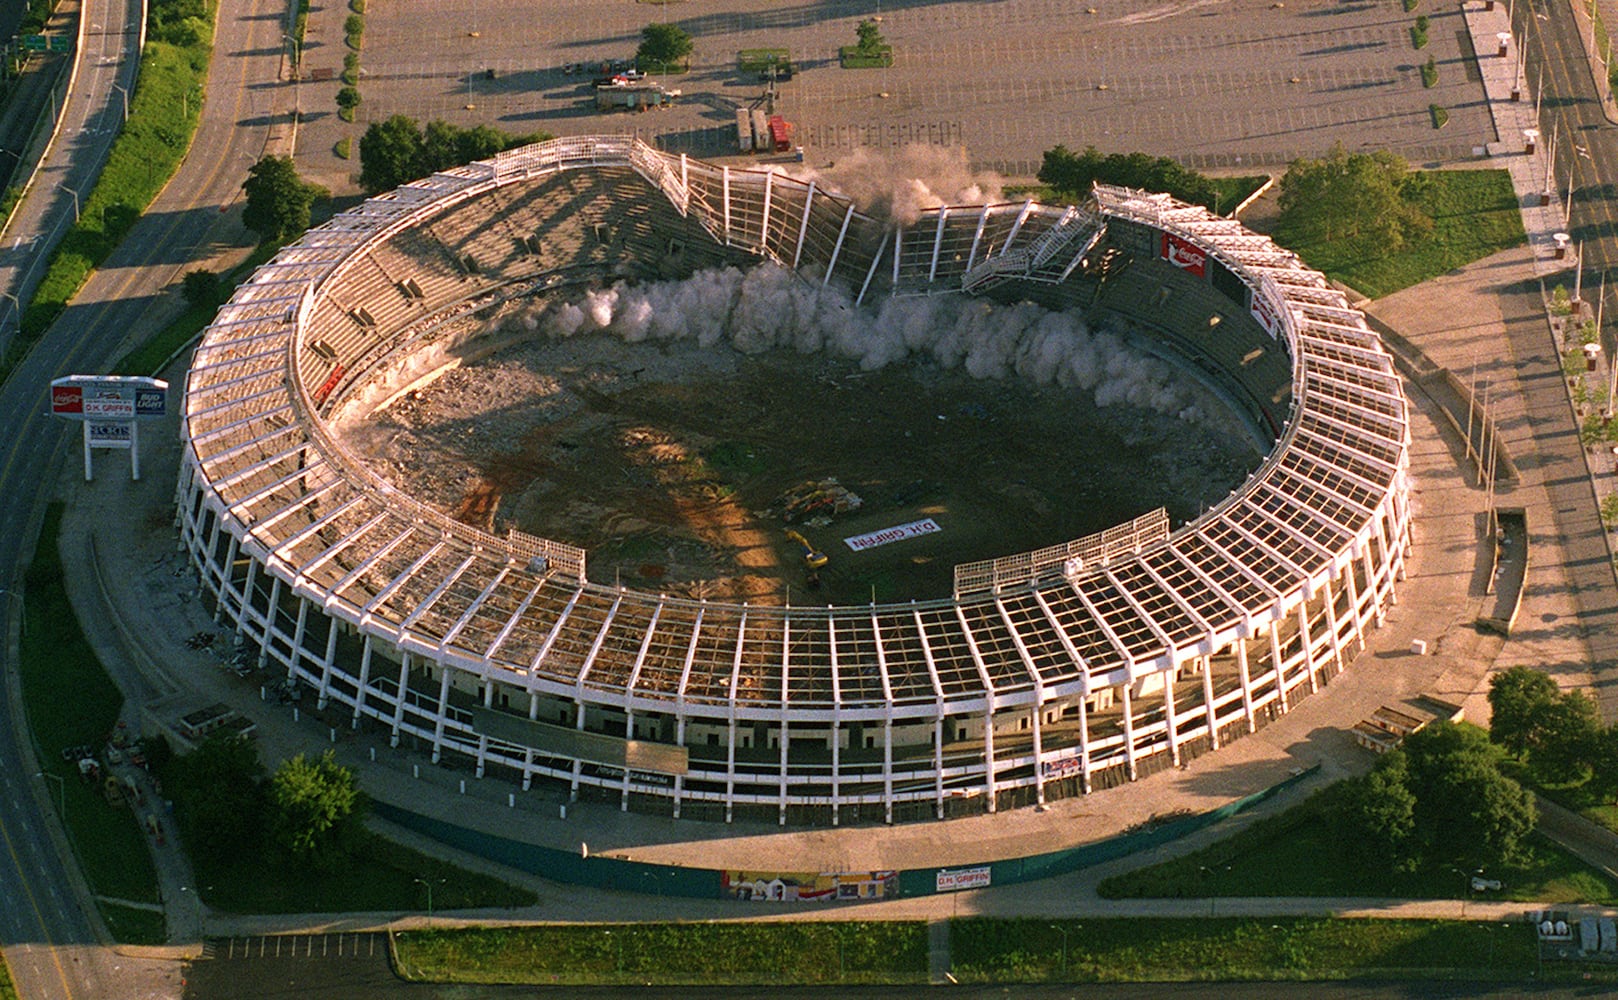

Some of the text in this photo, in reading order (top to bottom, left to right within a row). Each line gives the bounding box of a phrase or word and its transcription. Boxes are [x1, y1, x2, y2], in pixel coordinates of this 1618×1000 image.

[140, 393, 160, 401] BUD
[103, 404, 132, 412] GRIFFIN
[137, 401, 163, 409] LIGHT
[852, 521, 936, 548] D.H. GRIFFIN
[956, 872, 989, 883] GRIFFIN
